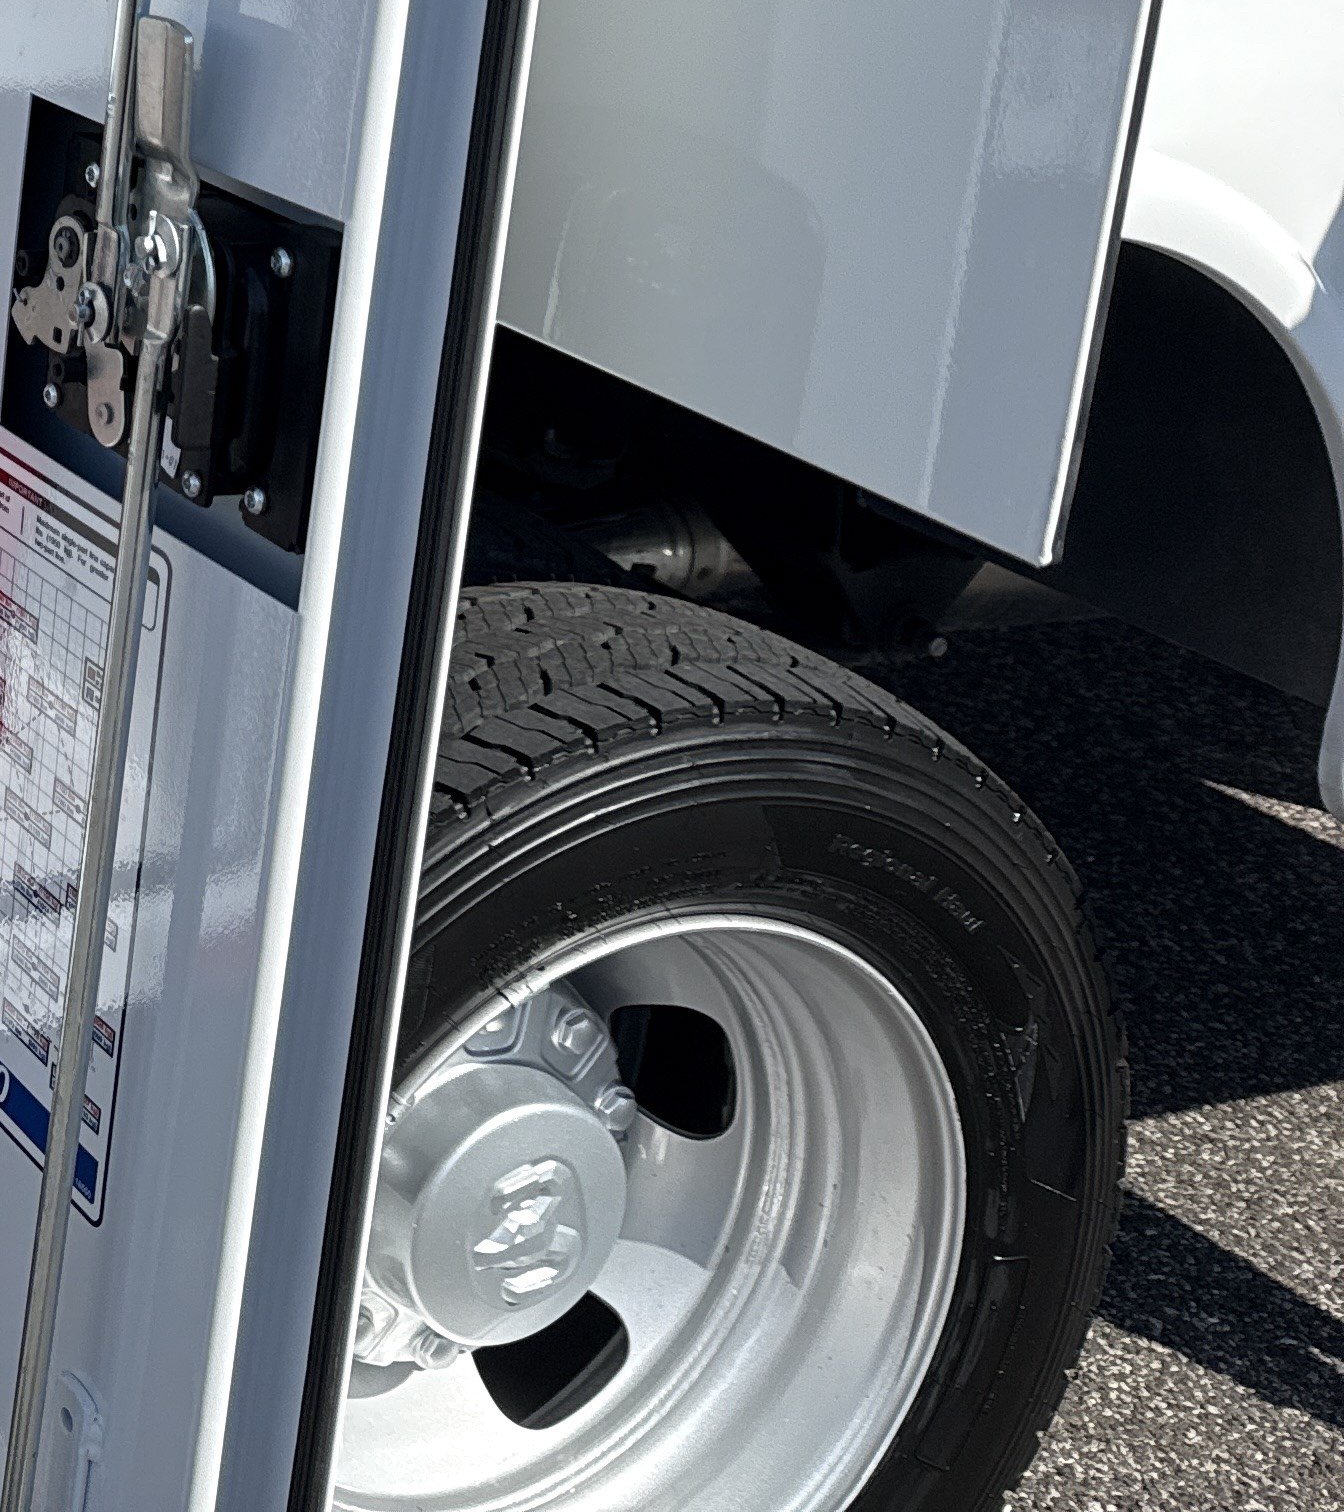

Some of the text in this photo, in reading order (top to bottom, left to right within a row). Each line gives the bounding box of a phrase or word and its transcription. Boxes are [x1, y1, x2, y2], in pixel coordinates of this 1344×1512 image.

[8, 477, 43, 508] IMPORTANT
[827, 833, 987, 935] Regional Haul
